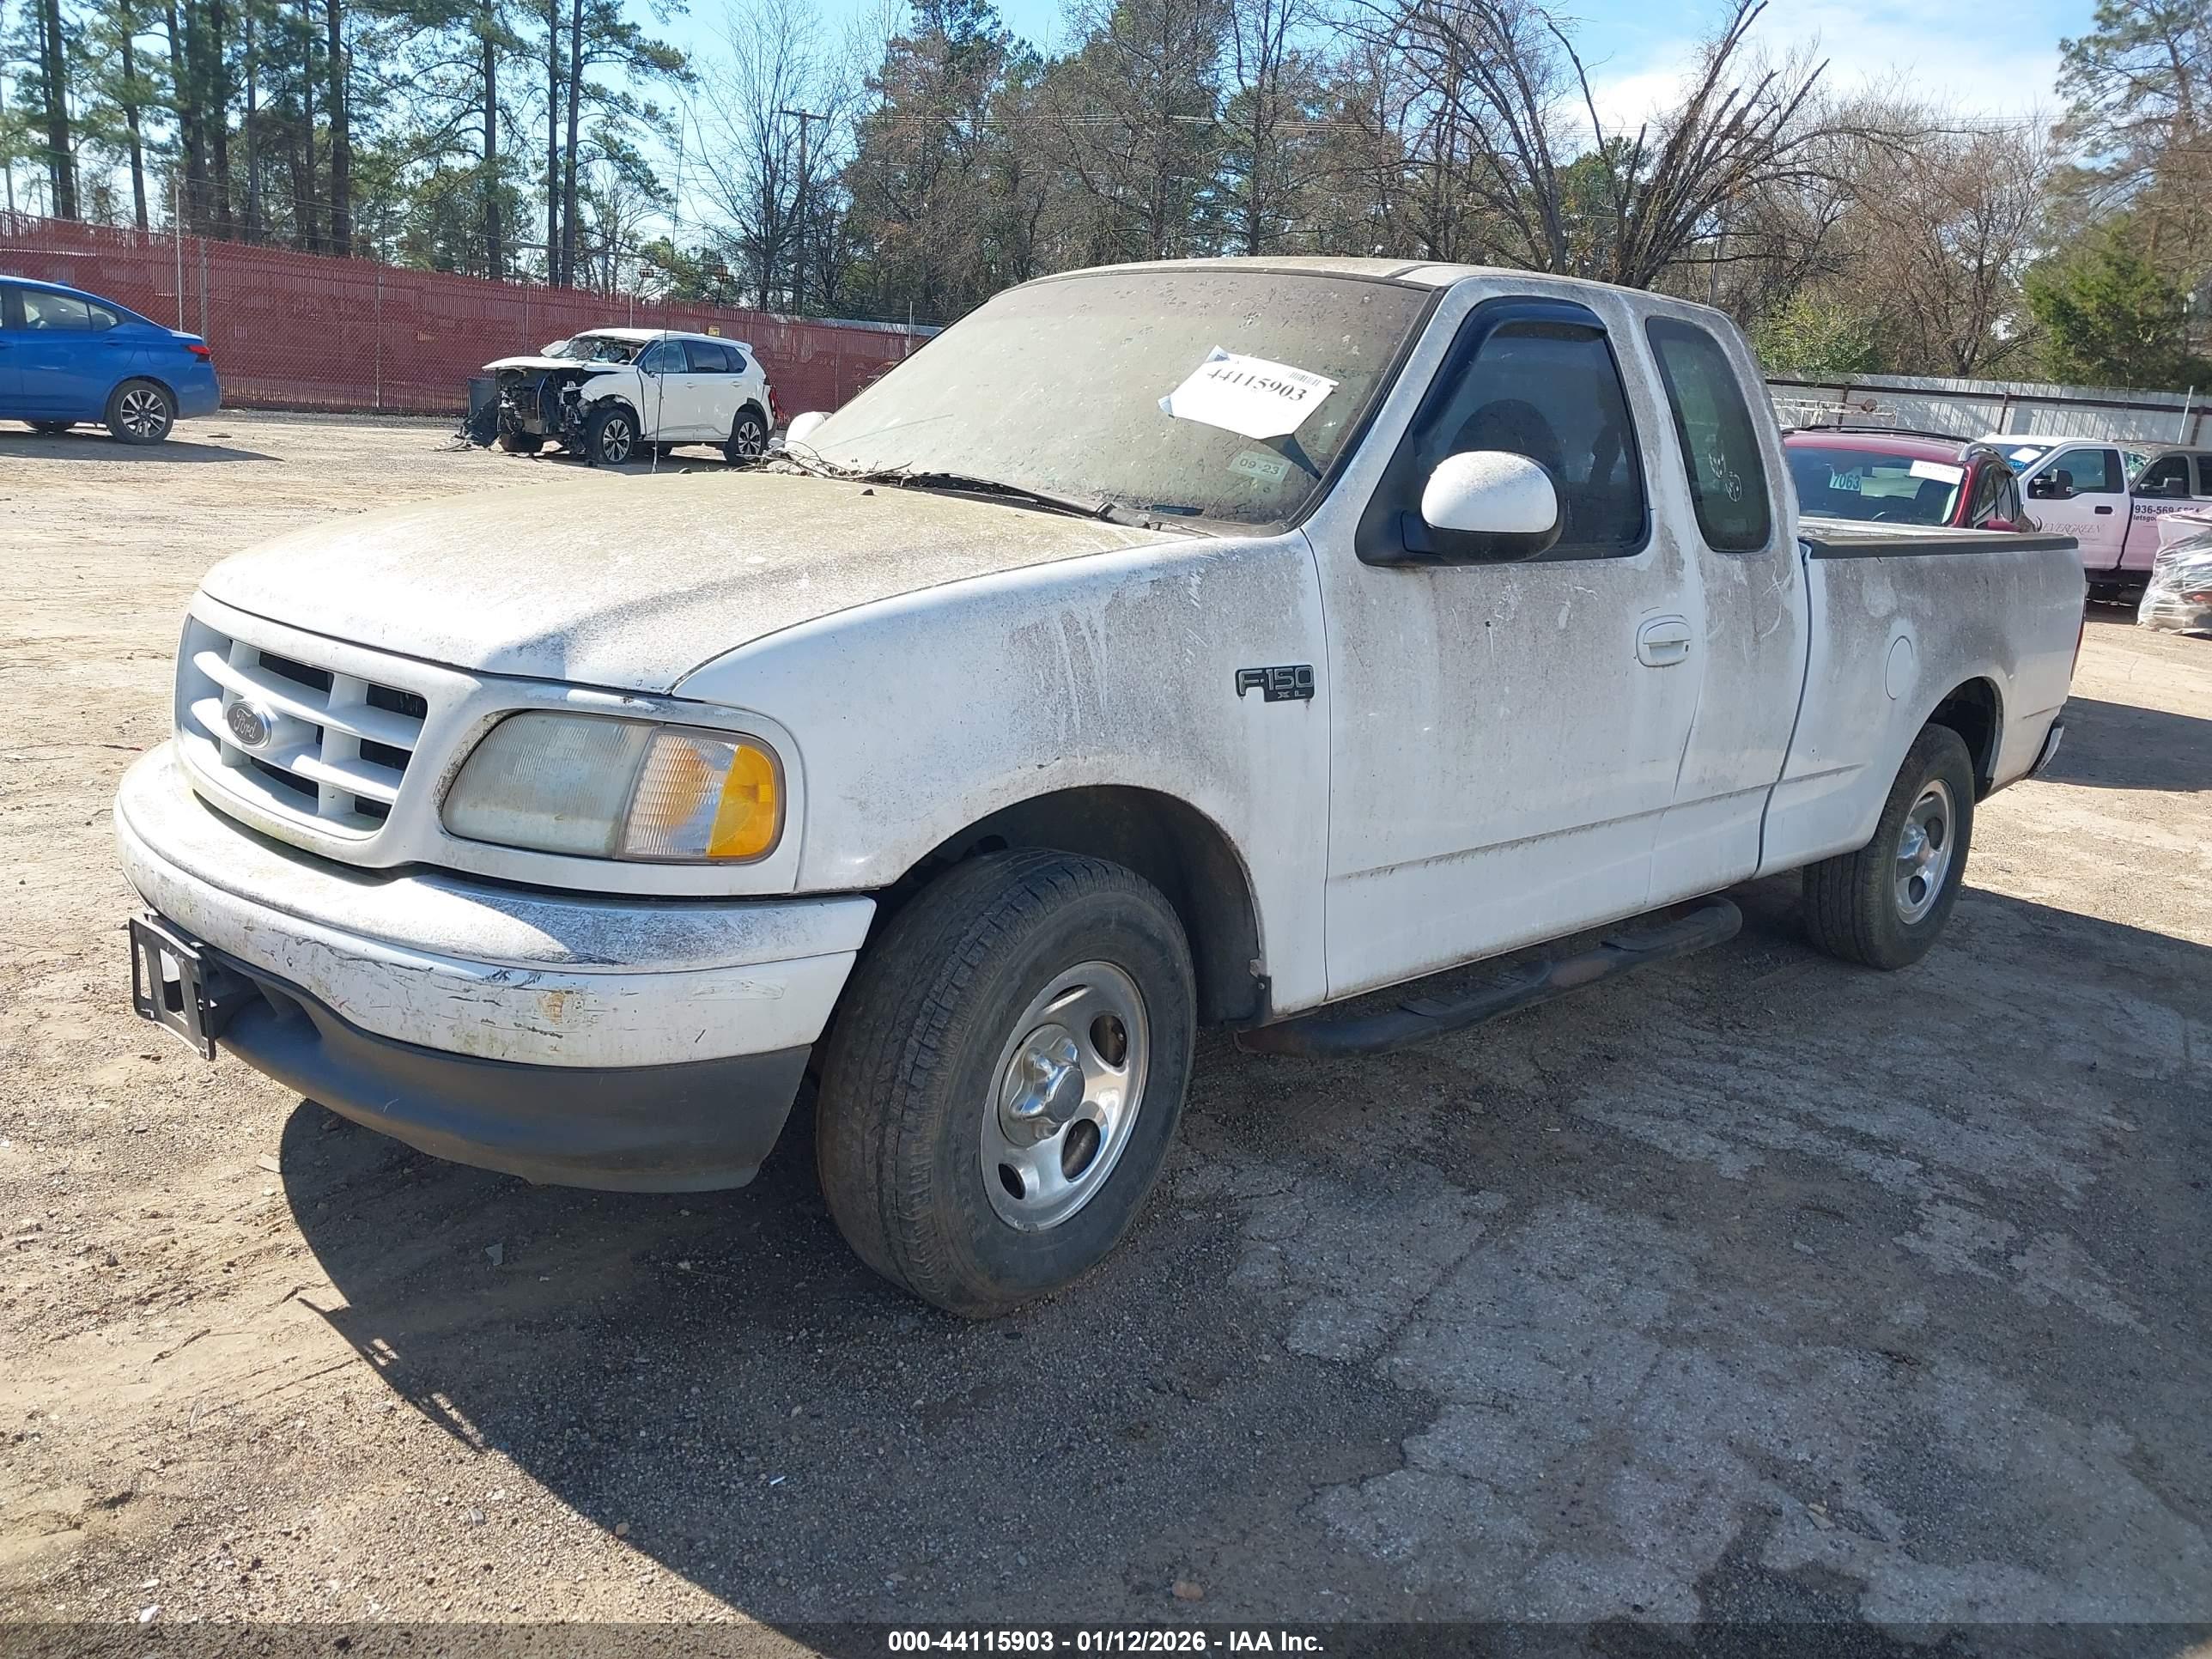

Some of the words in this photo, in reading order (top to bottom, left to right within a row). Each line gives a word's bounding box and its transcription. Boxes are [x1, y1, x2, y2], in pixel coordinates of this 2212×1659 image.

[1206, 368, 1307, 401] 44115903
[1832, 474, 1861, 489] 7063
[2135, 505, 2200, 514] 936-569-
[2043, 522, 2100, 535] EVERGREEN
[1238, 666, 1314, 695] F-150
[233, 708, 258, 738] Ford
